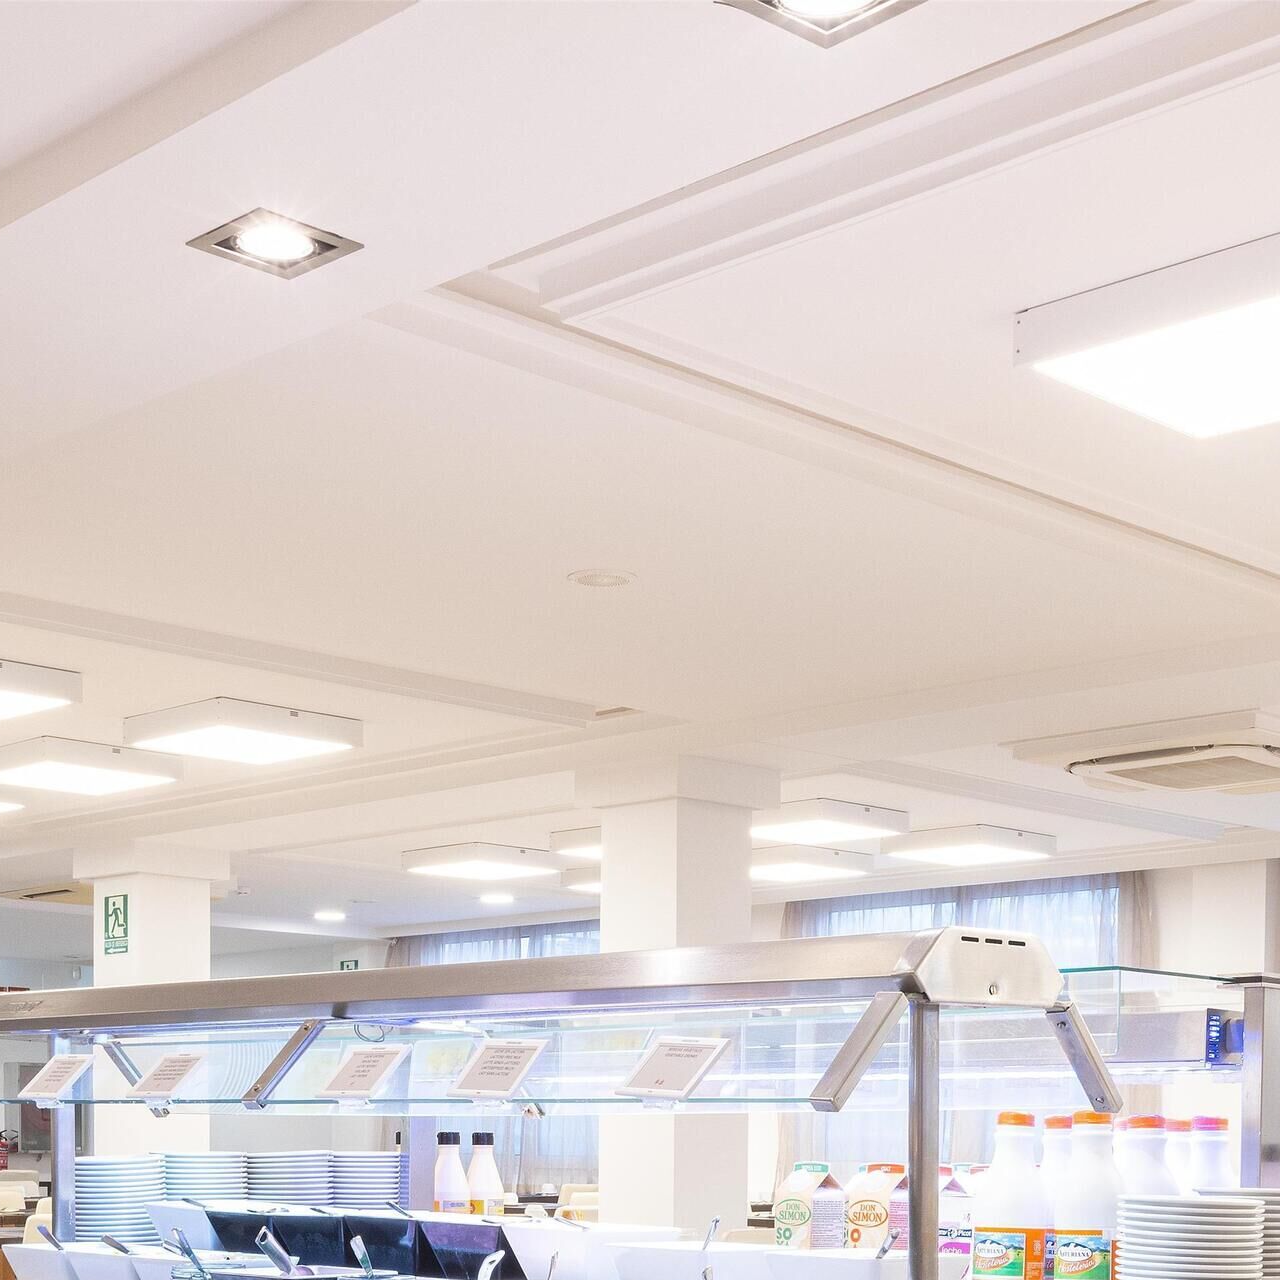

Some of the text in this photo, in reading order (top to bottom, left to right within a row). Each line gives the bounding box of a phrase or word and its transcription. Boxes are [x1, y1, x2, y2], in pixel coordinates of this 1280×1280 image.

[786, 1202, 800, 1210] DON
[780, 1210, 807, 1221] SIMON
[852, 1211, 883, 1222] SIMON
